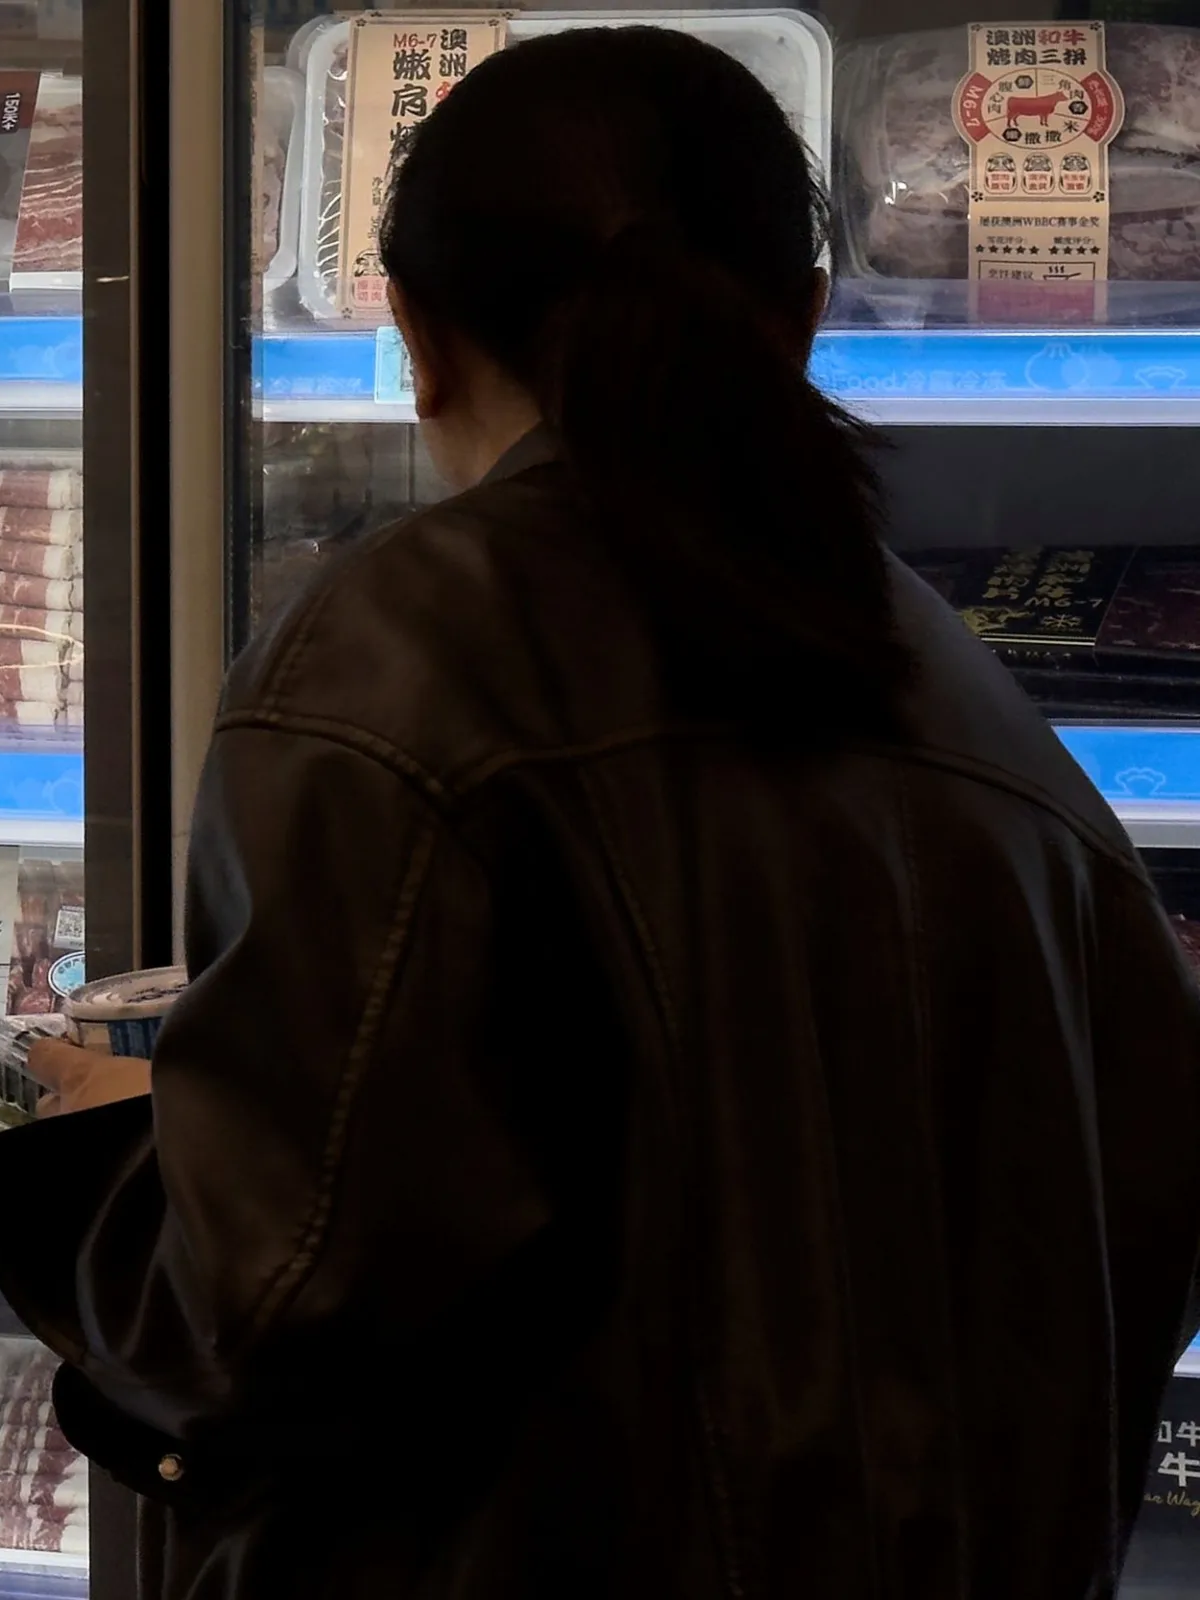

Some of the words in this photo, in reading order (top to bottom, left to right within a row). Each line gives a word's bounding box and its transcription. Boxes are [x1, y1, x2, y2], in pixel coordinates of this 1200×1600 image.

[393, 33, 437, 49] M6-7
[986, 29, 1087, 46] 澳洲和牛
[987, 48, 1087, 65] 烤肉三拼
[963, 85, 983, 127] M6-7
